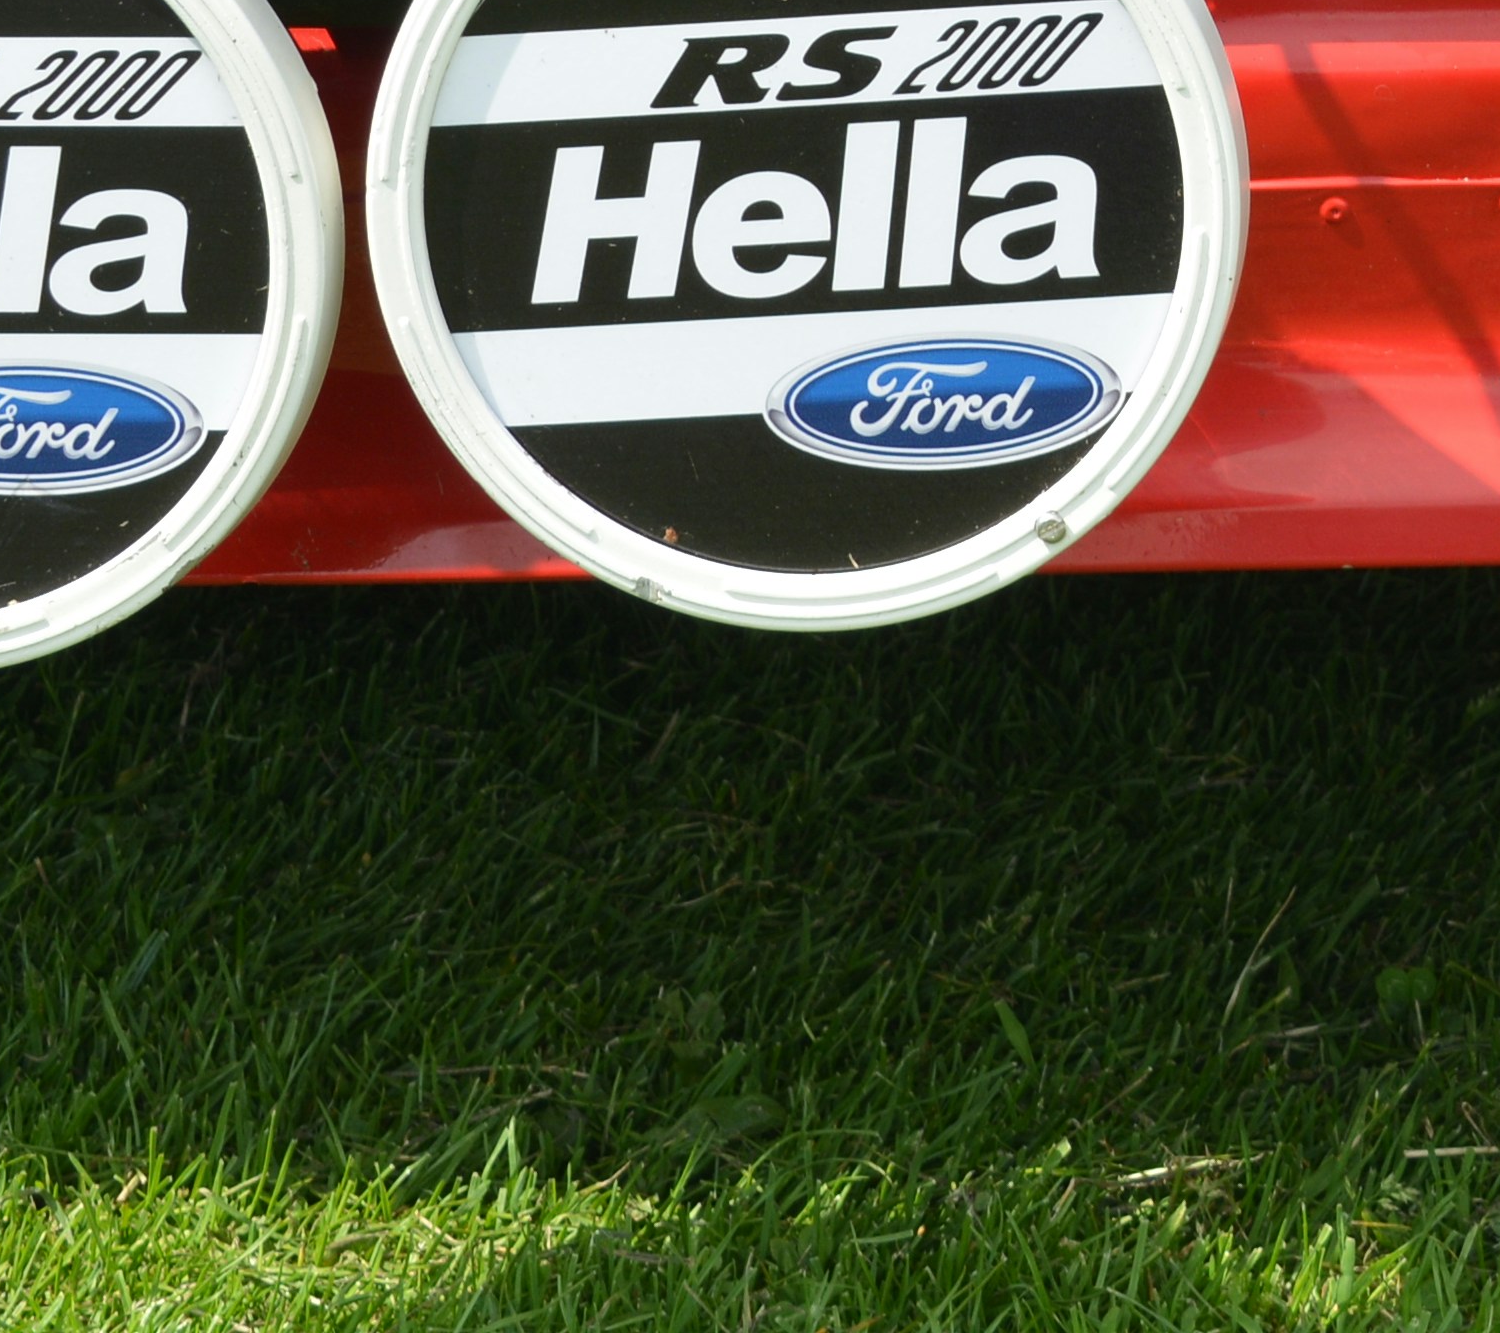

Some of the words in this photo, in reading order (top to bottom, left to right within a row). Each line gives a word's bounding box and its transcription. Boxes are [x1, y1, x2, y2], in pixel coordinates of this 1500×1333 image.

[650, 26, 899, 108] RS
[893, 12, 1103, 95] 2000
[531, 116, 1100, 305] Hella
[849, 361, 1035, 436] Ford
